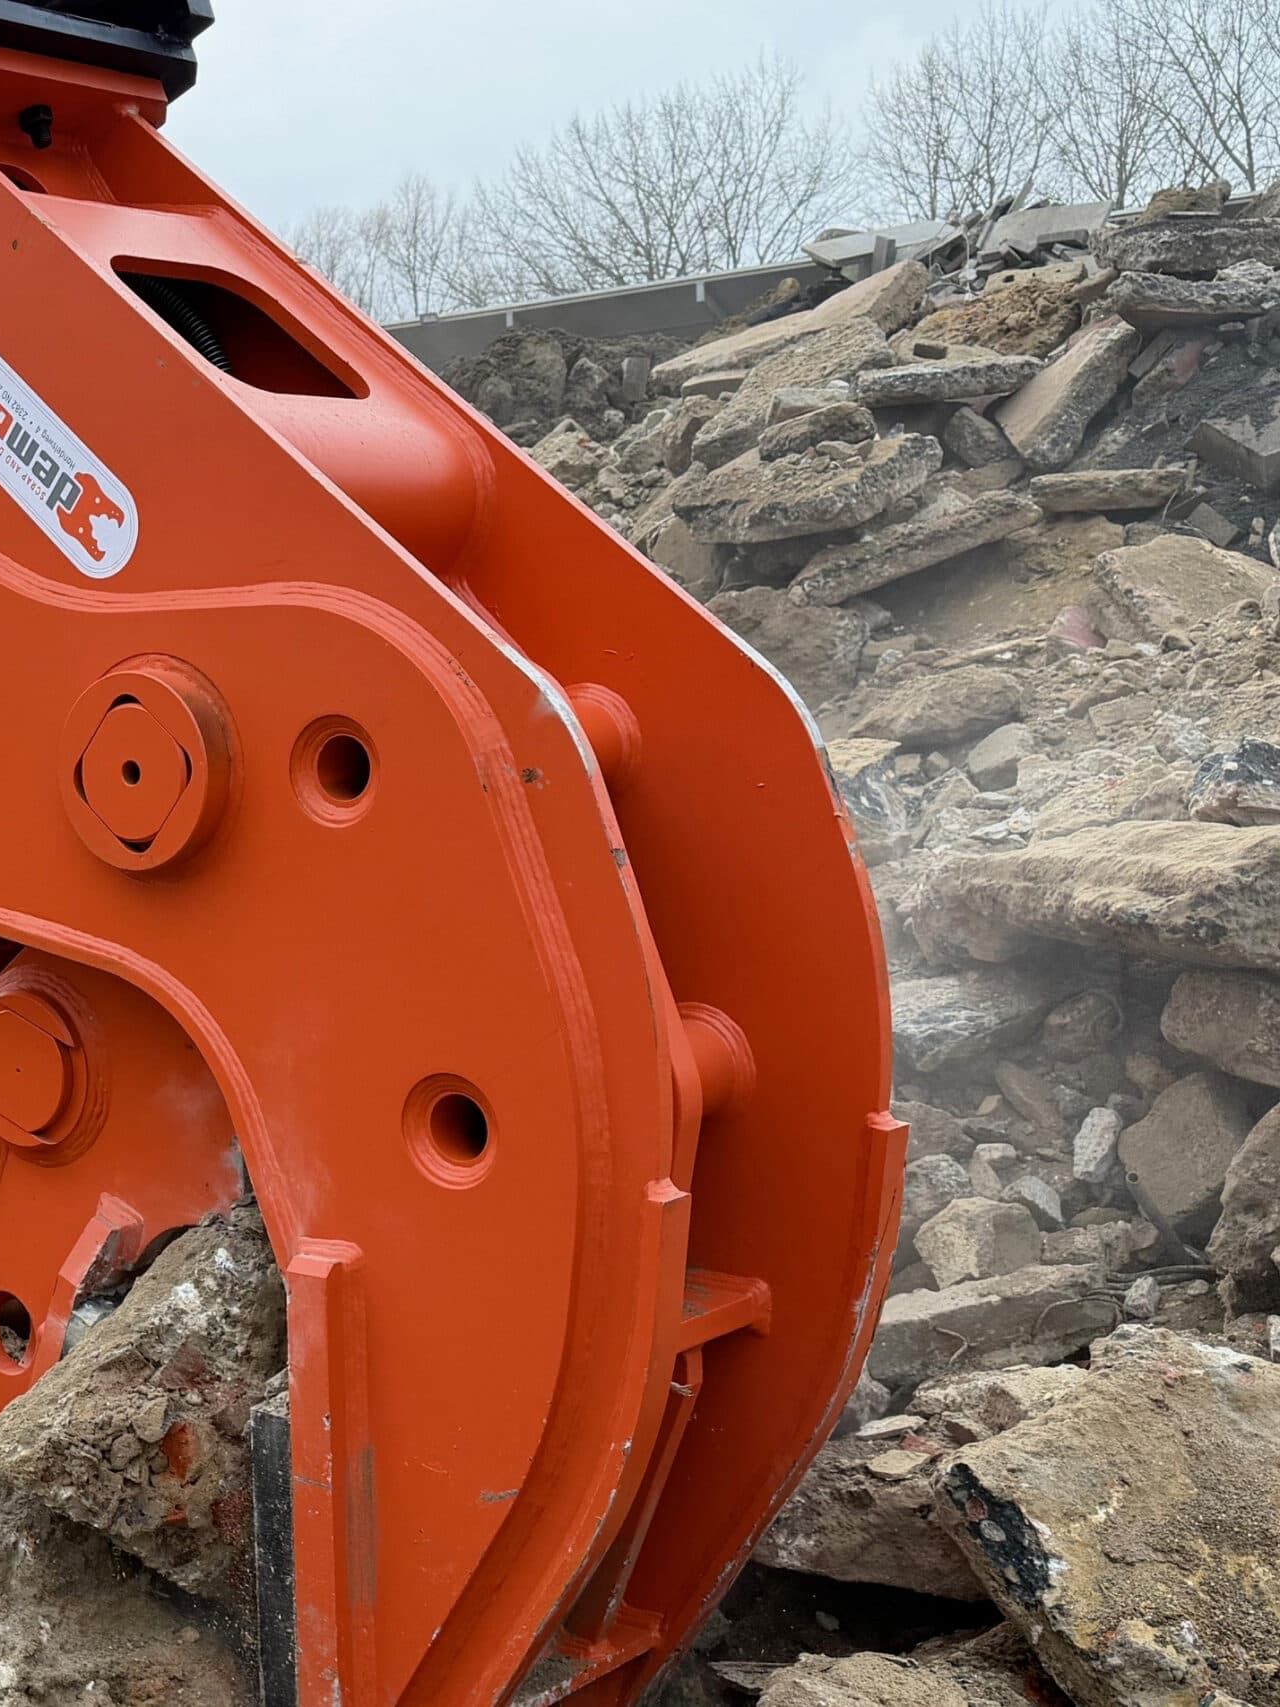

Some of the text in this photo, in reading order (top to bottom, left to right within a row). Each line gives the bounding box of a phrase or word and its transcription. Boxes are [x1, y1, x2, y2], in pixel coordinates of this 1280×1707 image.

[12, 400, 29, 422] 2382
[4, 455, 22, 475] AND
[21, 475, 46, 500] SCRAP
